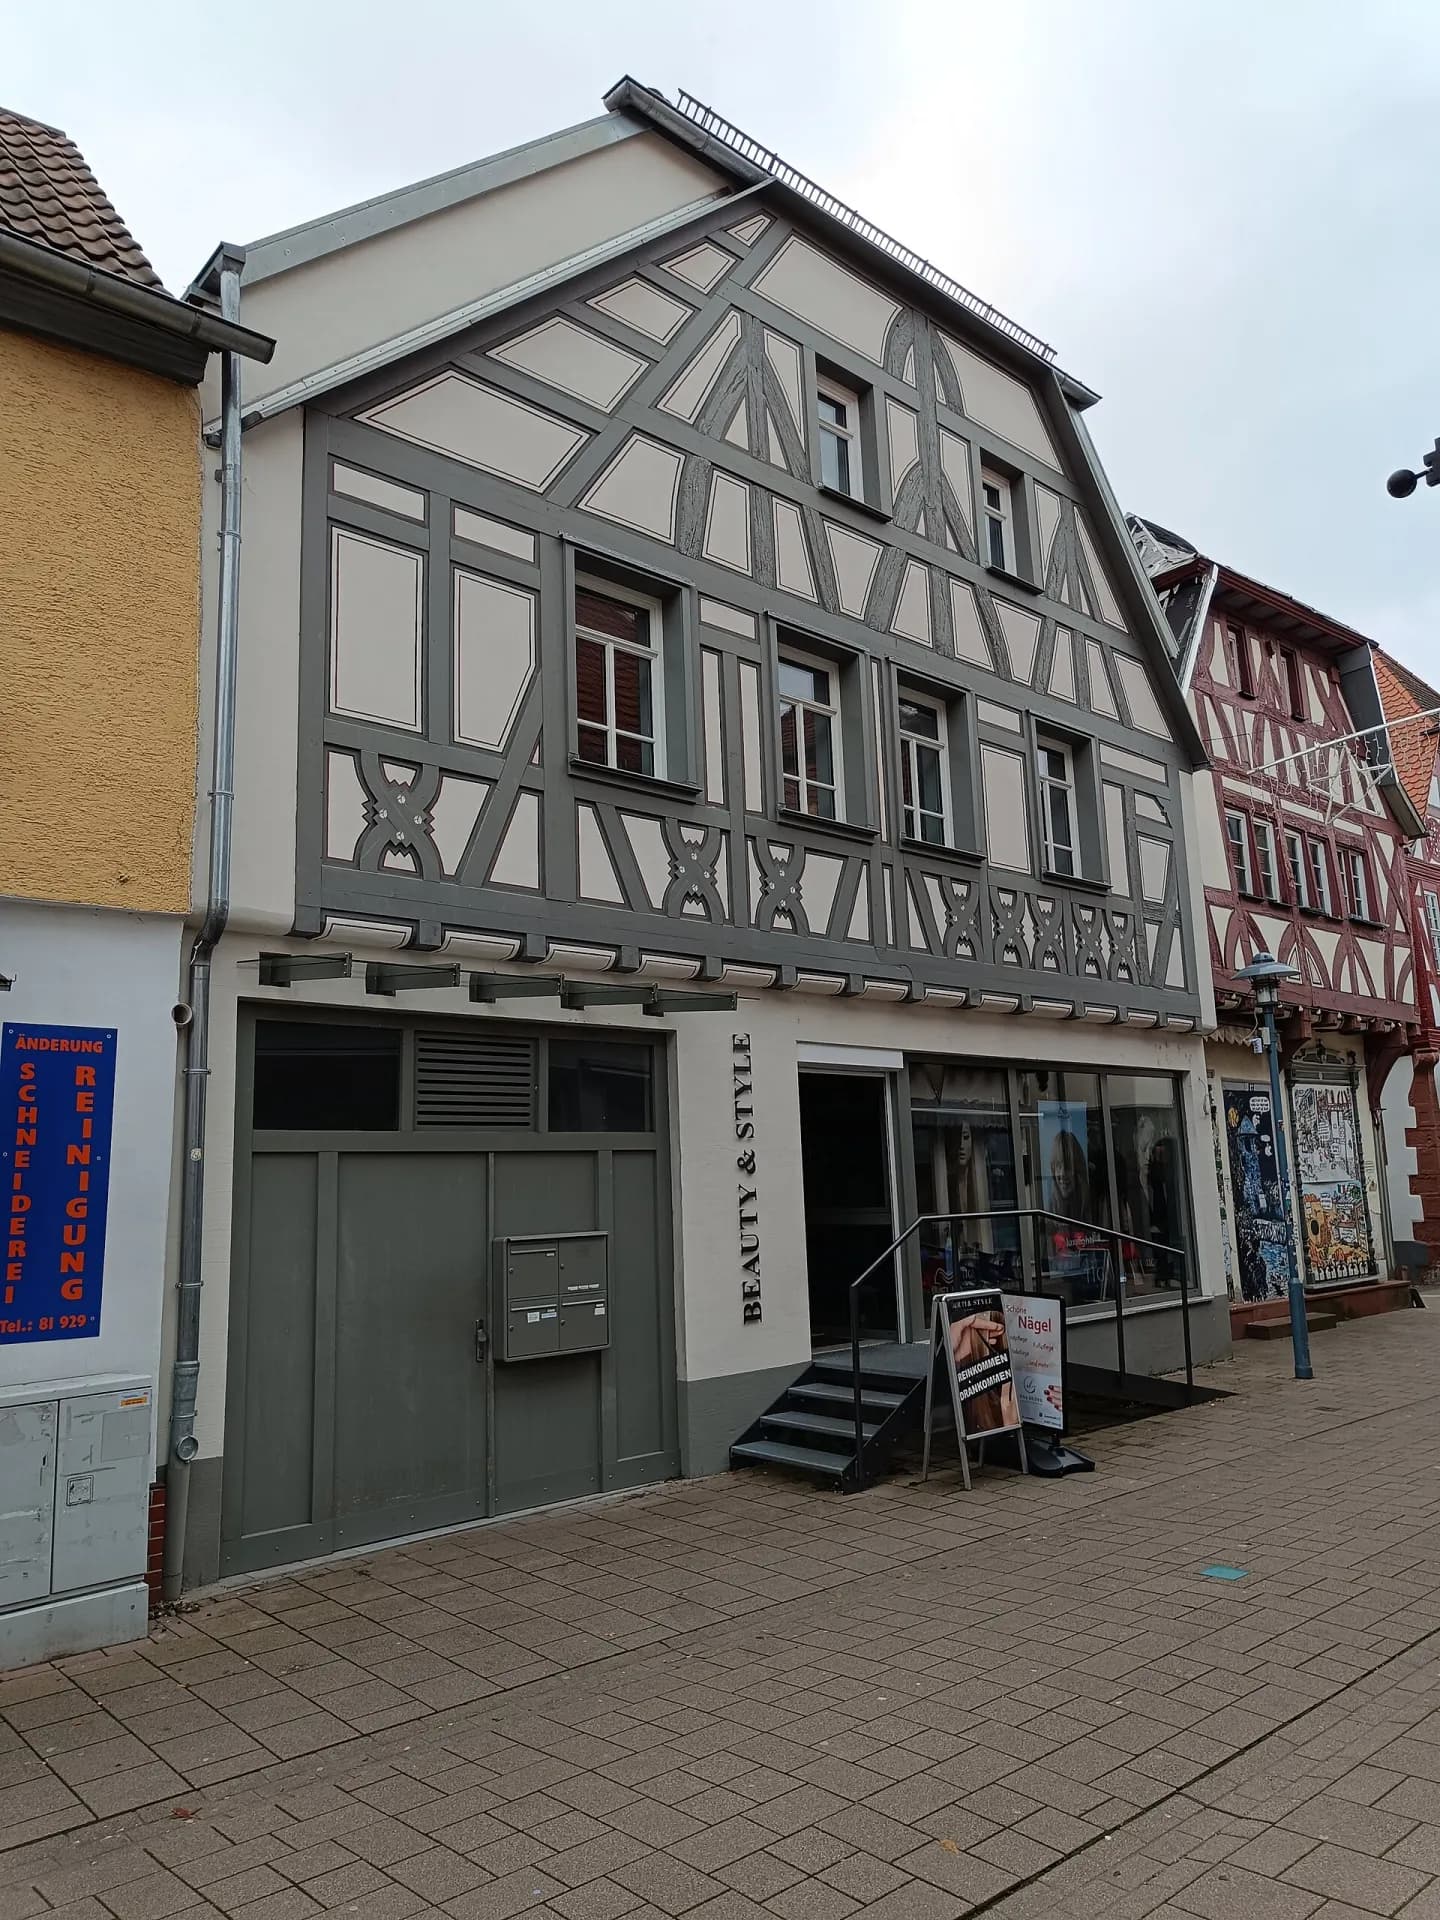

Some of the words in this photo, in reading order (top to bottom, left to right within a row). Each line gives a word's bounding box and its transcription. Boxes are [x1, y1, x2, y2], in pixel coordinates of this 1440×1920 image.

[15, 1033, 104, 1054] ÄNDERUNG
[731, 1032, 755, 1139] STYLE
[736, 1149, 756, 1175] &
[5, 1062, 38, 1304] SCHNEIDEREI
[60, 1065, 97, 1301] REINIGUNG
[738, 1183, 763, 1325] BEAUTY
[0, 1318, 33, 1333] Tel.:
[59, 1314, 87, 1329] 929
[1018, 1314, 1052, 1335] Nägel
[957, 1352, 1009, 1384] REINKOMMEN
[959, 1367, 1013, 1401] DRANKOMMEN
